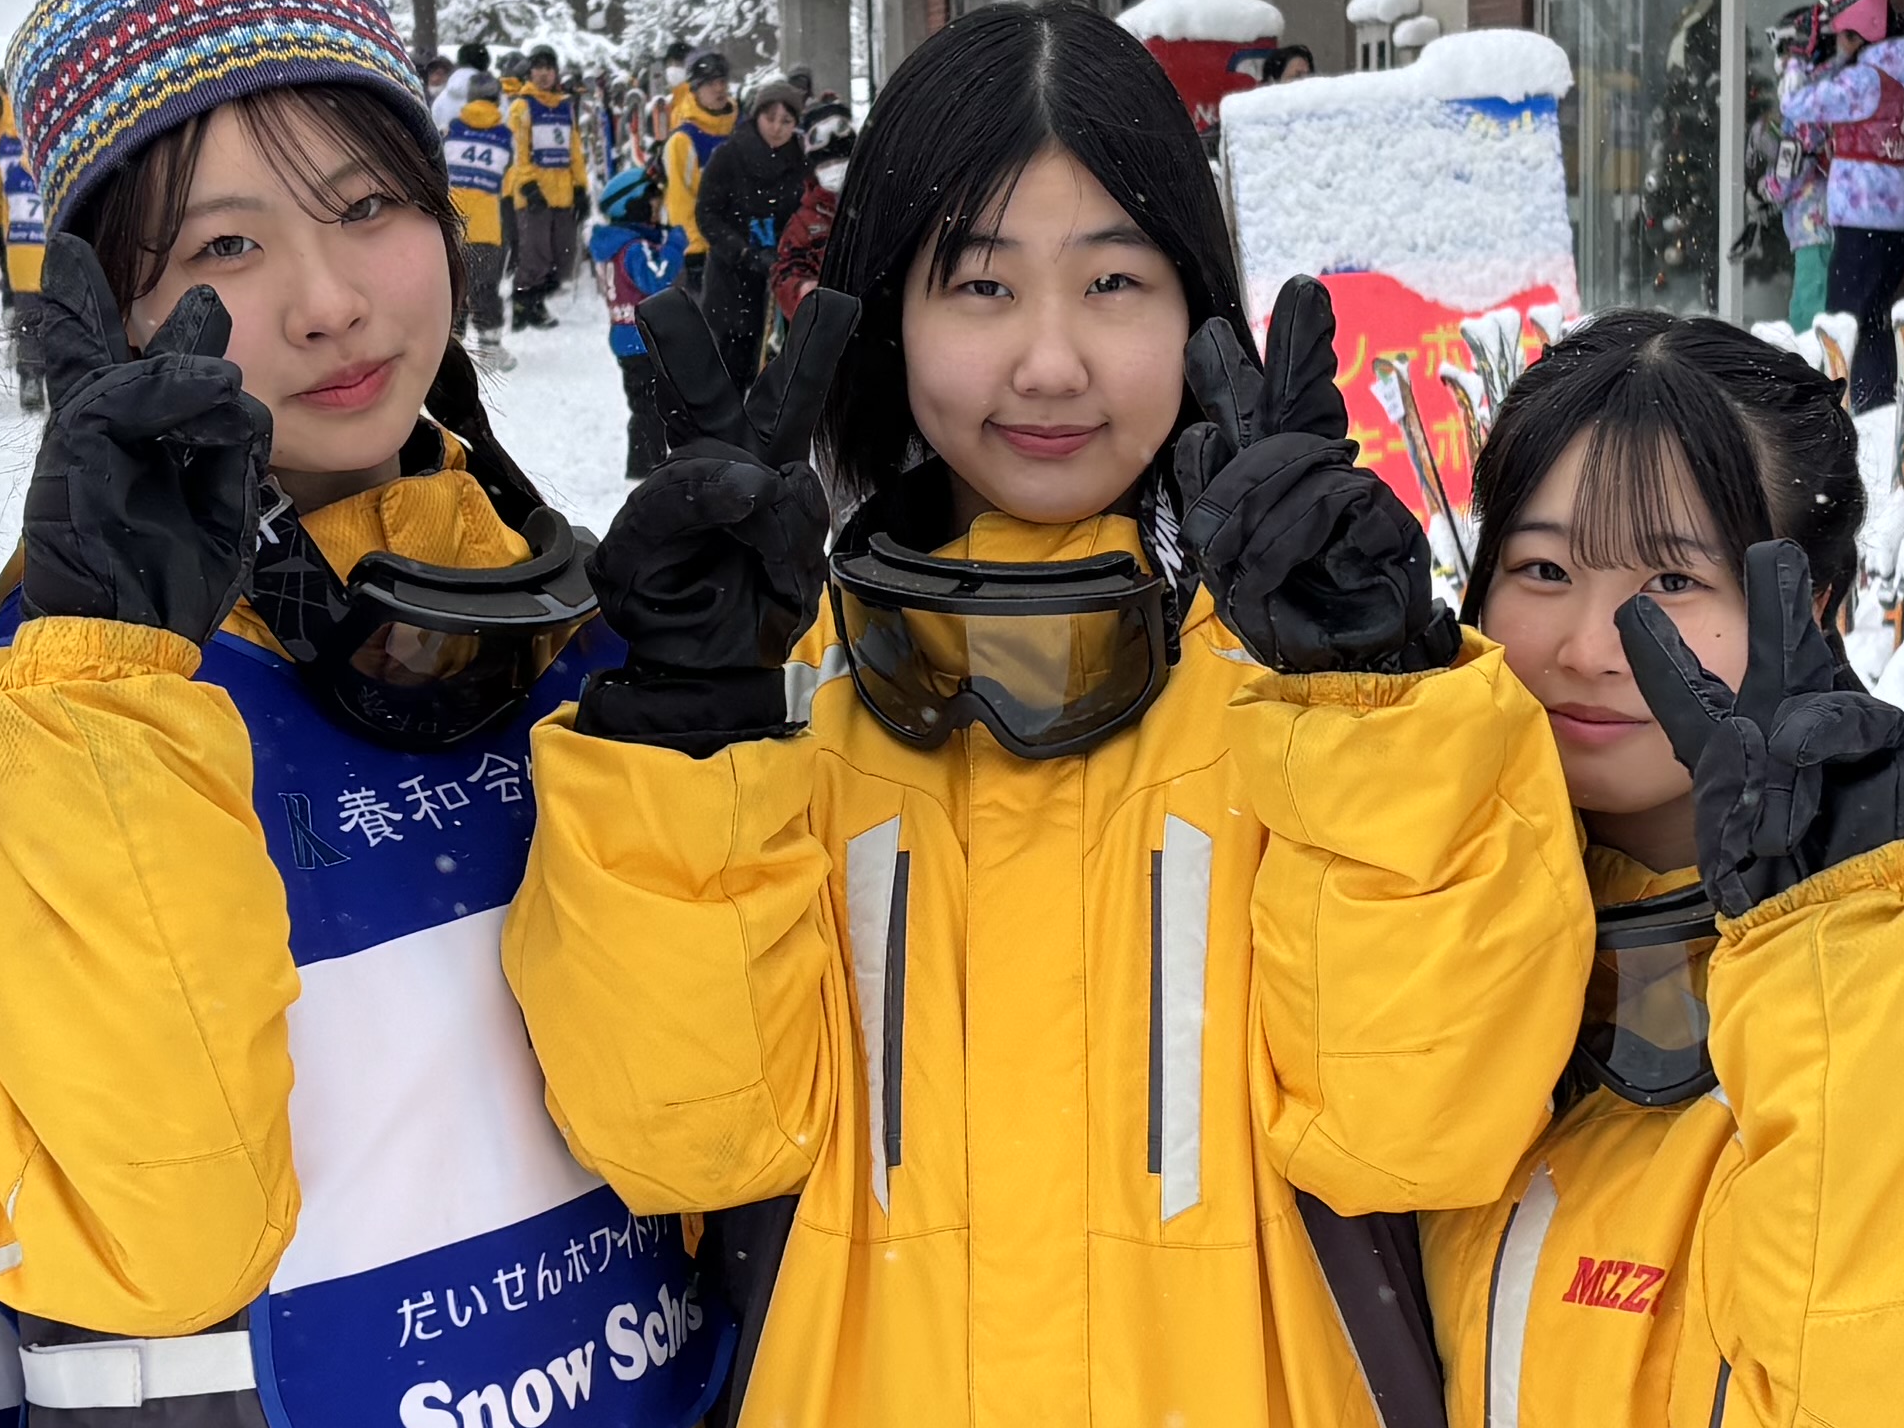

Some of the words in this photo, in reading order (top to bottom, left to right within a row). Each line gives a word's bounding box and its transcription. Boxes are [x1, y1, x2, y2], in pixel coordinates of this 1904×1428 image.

[460, 145, 493, 166] 44
[337, 752, 533, 848] 養和会
[396, 1213, 668, 1348] だいせんホワイトリ
